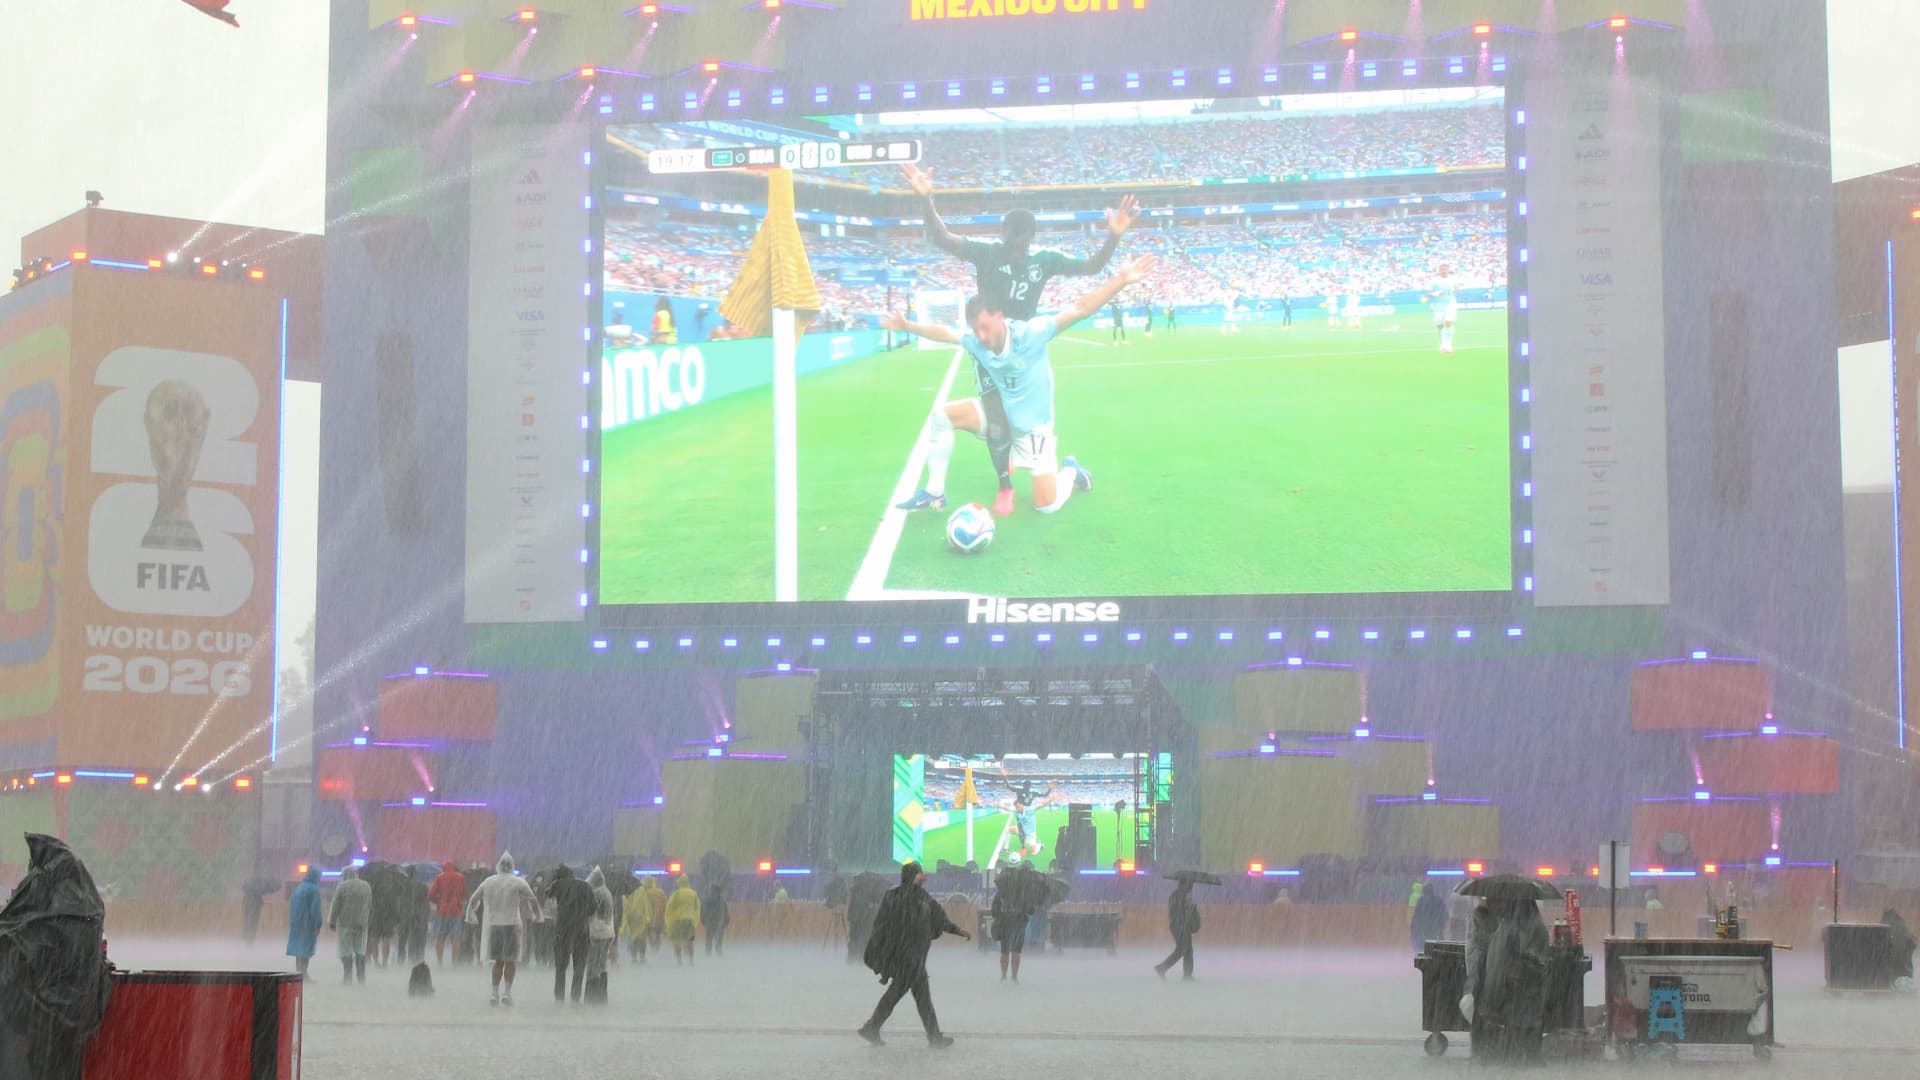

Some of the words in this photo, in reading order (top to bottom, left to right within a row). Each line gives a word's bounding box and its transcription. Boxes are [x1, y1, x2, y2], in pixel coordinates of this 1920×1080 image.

[786, 149, 795, 163] 0
[826, 147, 835, 161] 0
[1009, 280, 1028, 300] 12
[137, 562, 211, 592] FIFA
[967, 597, 1120, 624] Hisense
[85, 624, 192, 651] WORLD
[197, 630, 254, 655] CUP
[83, 654, 252, 697] 2026
